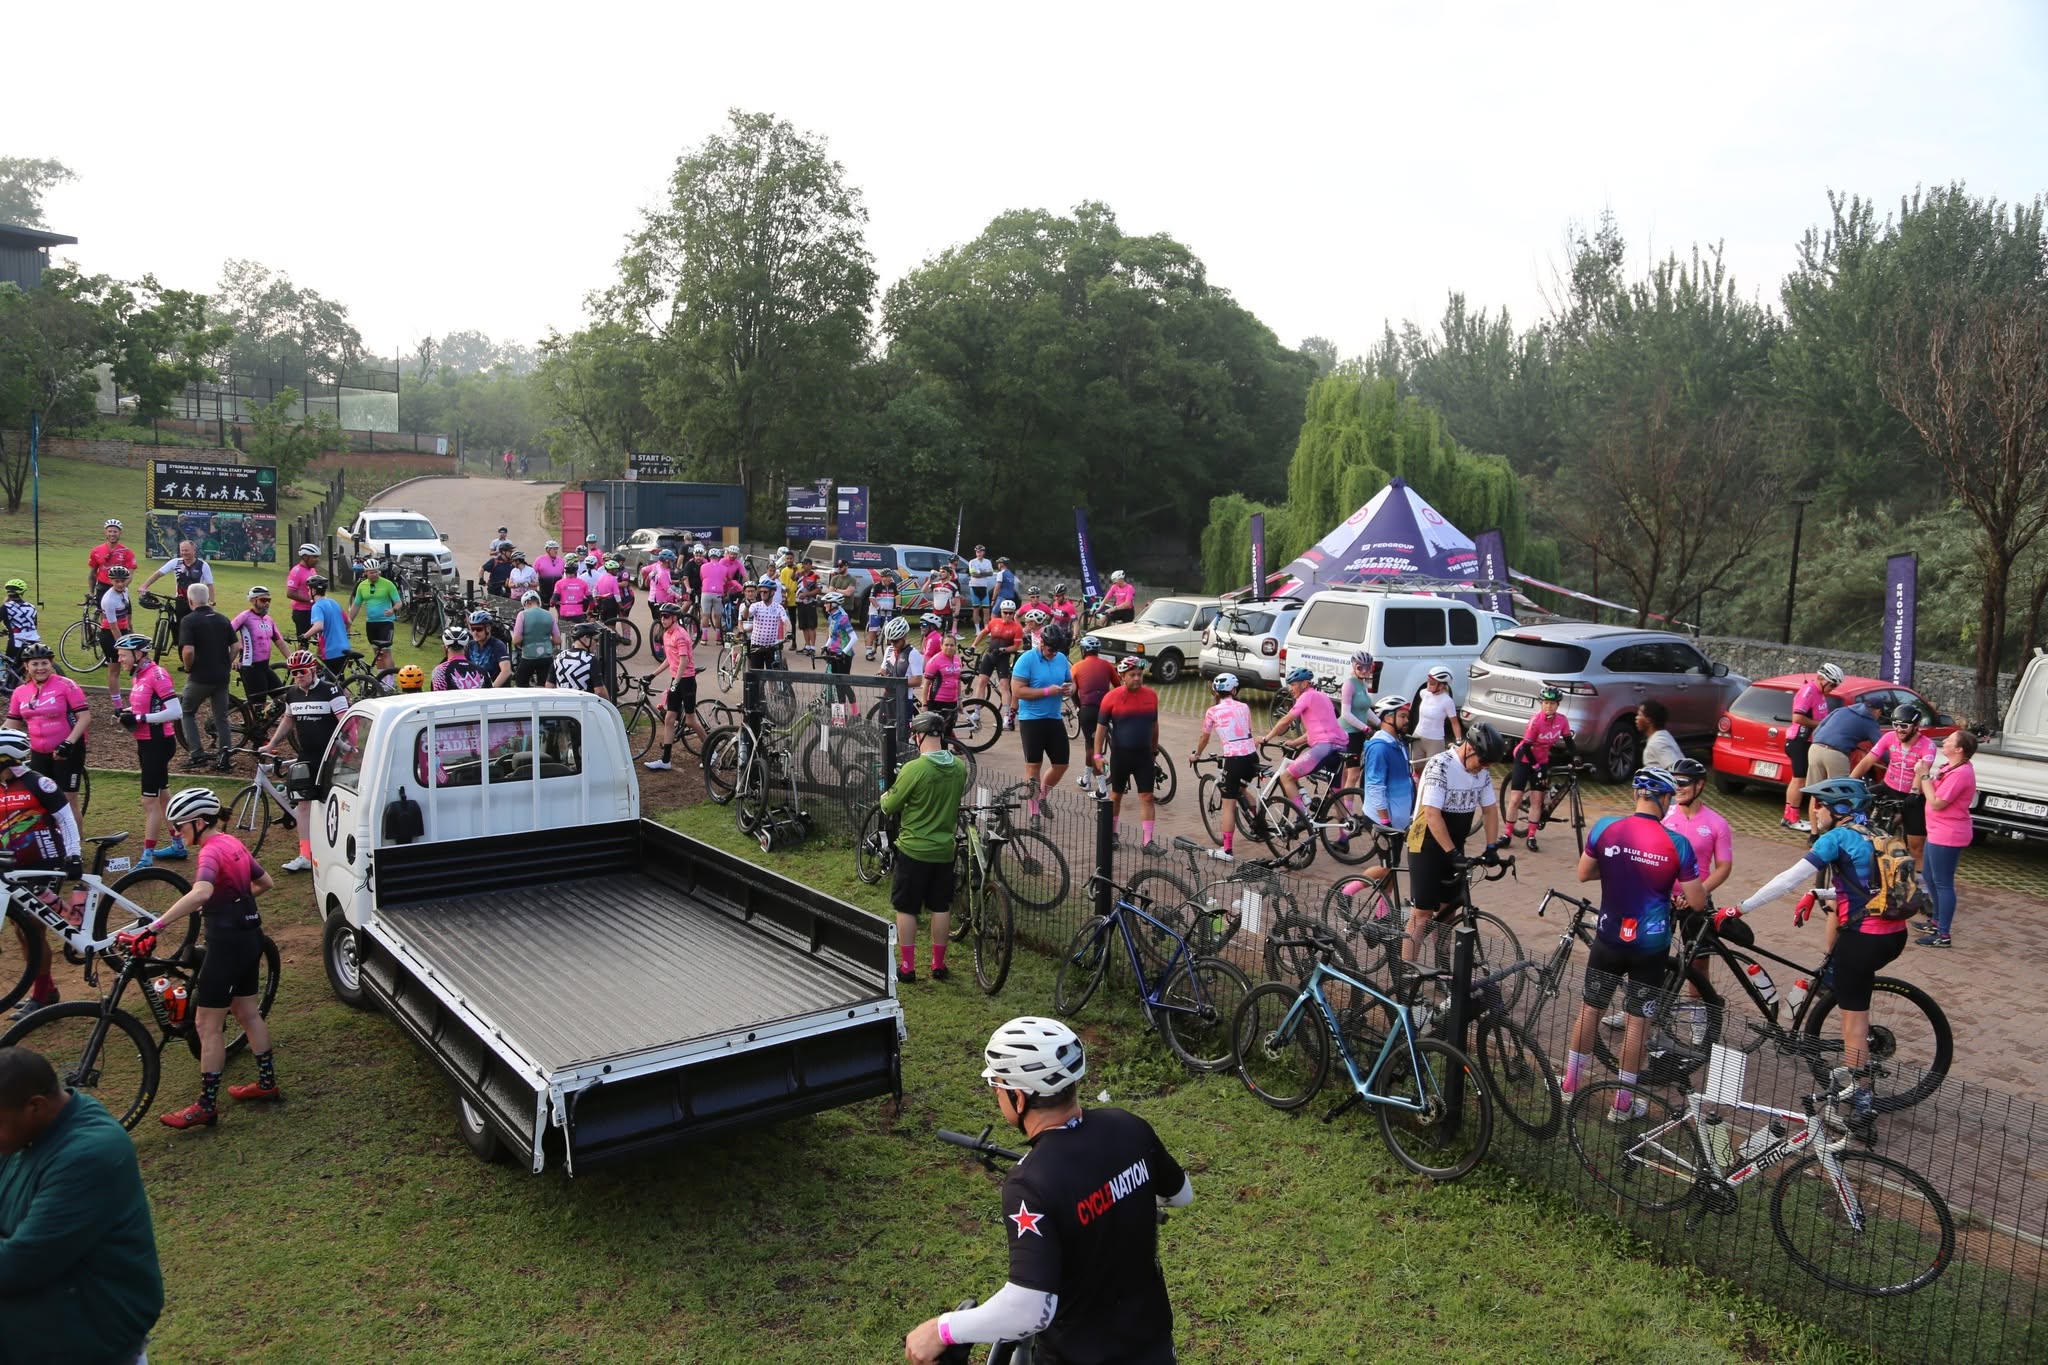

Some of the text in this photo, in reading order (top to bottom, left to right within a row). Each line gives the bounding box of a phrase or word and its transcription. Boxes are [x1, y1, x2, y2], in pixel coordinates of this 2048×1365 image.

[638, 454, 659, 462] START
[1372, 542, 1415, 550] FEDGROUP
[1078, 532, 1092, 583] FEDGROUP
[1353, 556, 1410, 566] GET YOUR
[1344, 562, 1418, 571] MEMBERSHIP
[1304, 661, 1345, 676] ISUZU
[459, 729, 478, 739] THE
[1987, 797, 2046, 815] MD 34 HL GP
[40, 829, 59, 859] SIMPLE
[1623, 847, 1669, 862] BLUE BOTTLE
[1630, 855, 1660, 867] LIQUORS
[15, 885, 81, 941] TREK
[1756, 1141, 1793, 1172] BMC
[1076, 1158, 1150, 1226] CYCLENATION
